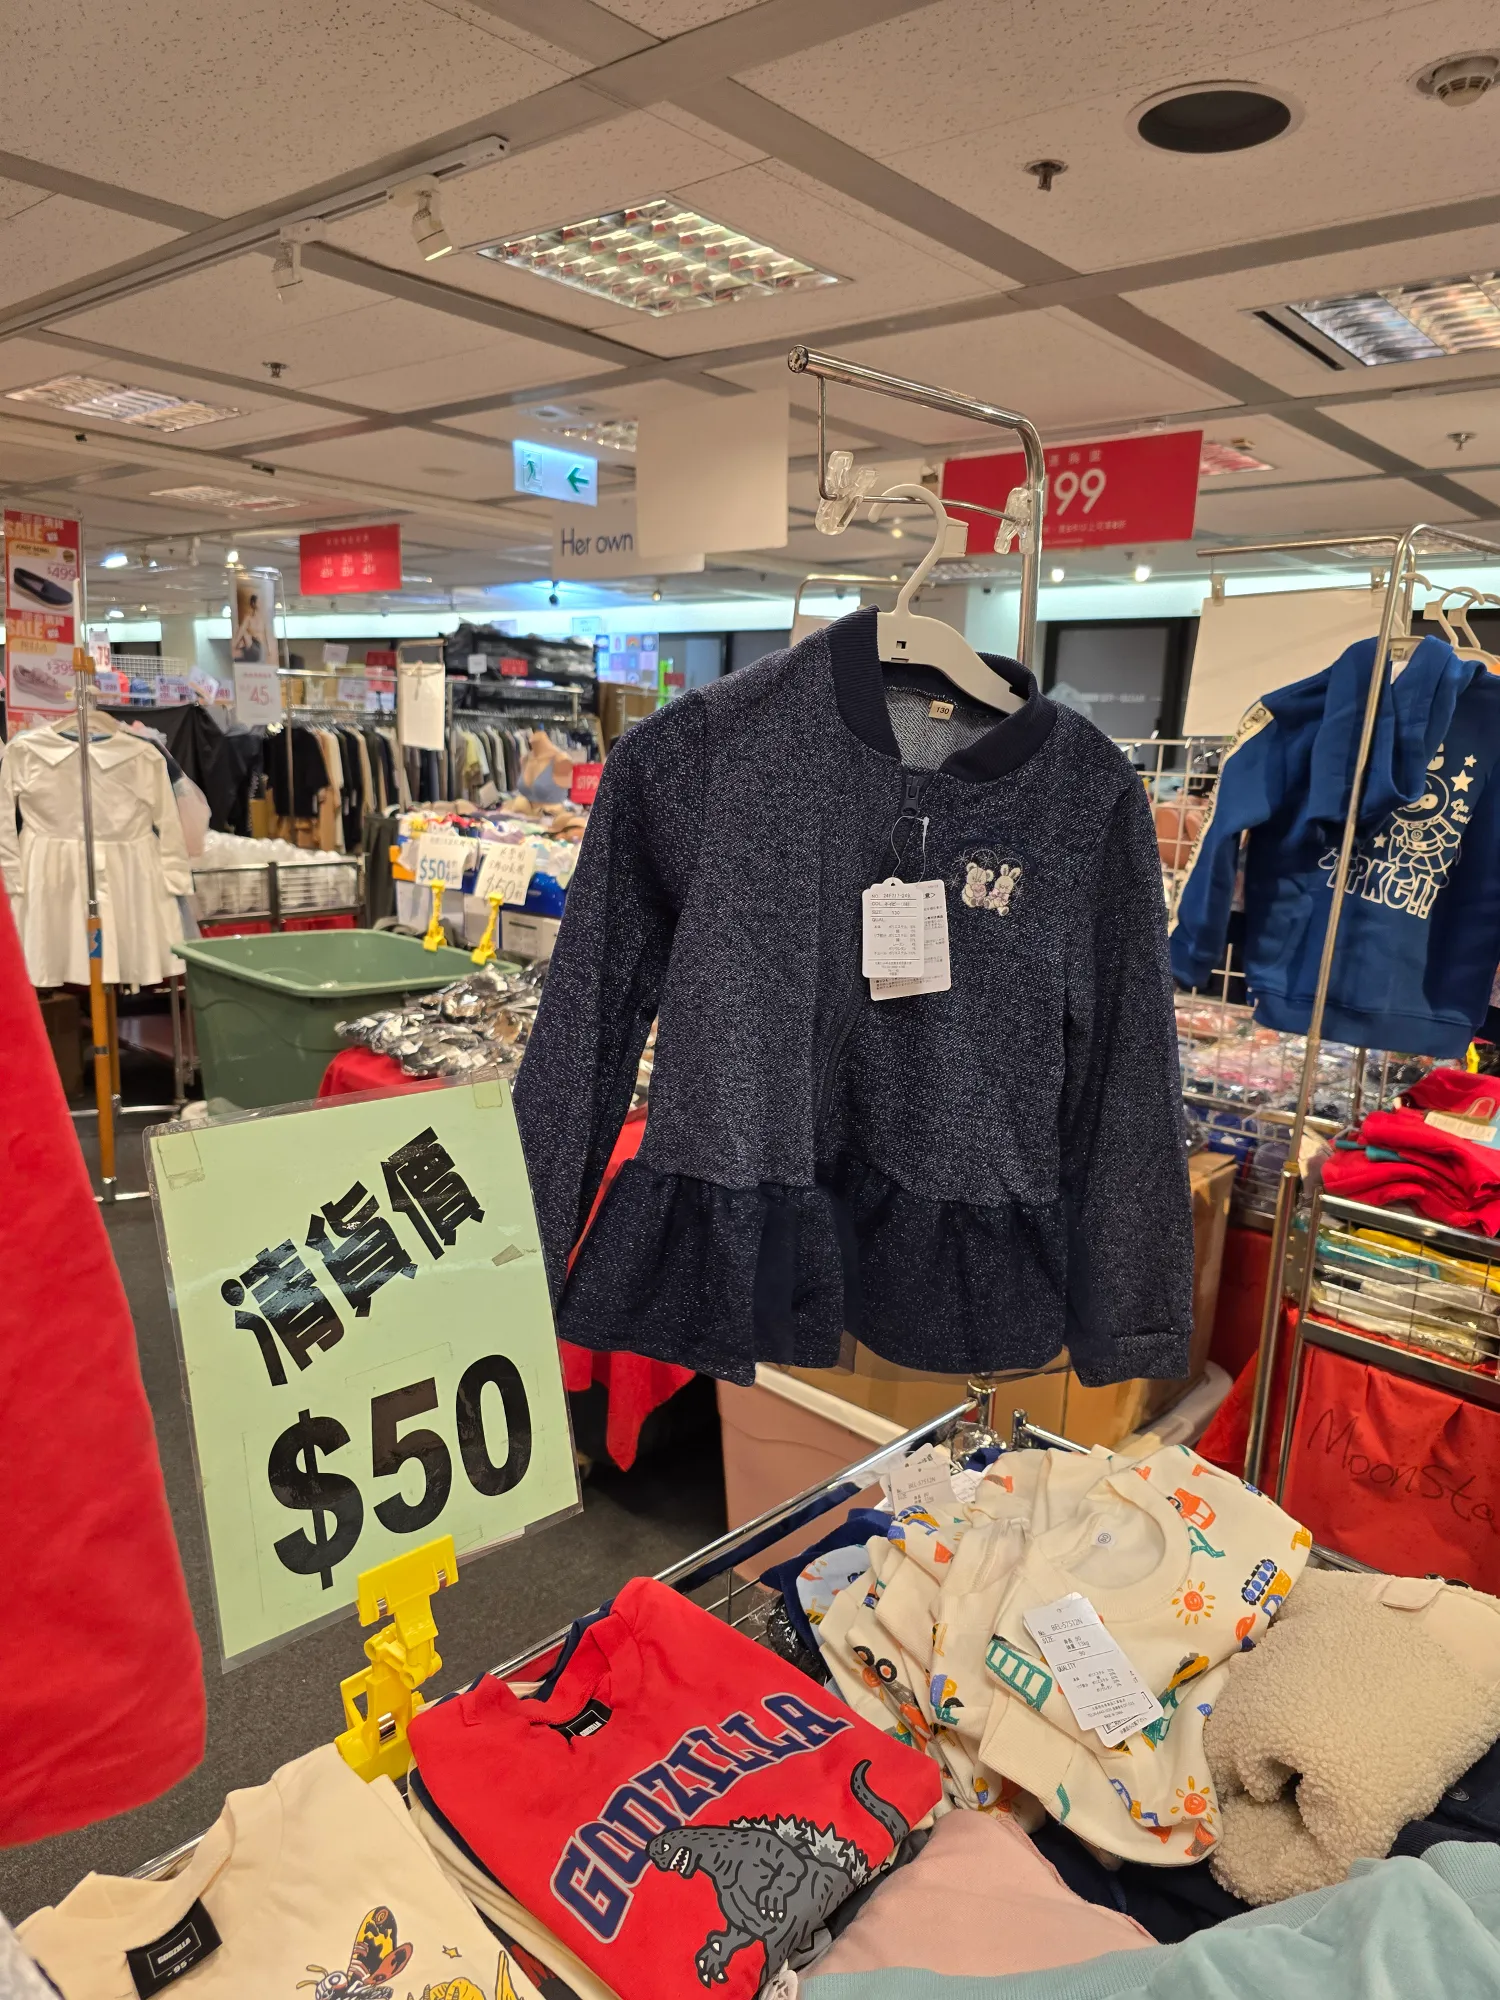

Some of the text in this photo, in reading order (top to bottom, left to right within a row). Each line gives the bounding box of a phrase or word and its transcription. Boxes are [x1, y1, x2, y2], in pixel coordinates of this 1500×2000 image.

[561, 527, 634, 557] Her own
[936, 706, 950, 715] 130
[220, 1126, 485, 1387] 清貨價
[267, 1354, 532, 1591] $50
[550, 1692, 855, 1944] GODZILLA
[157, 1937, 191, 1964] GODZILLA
